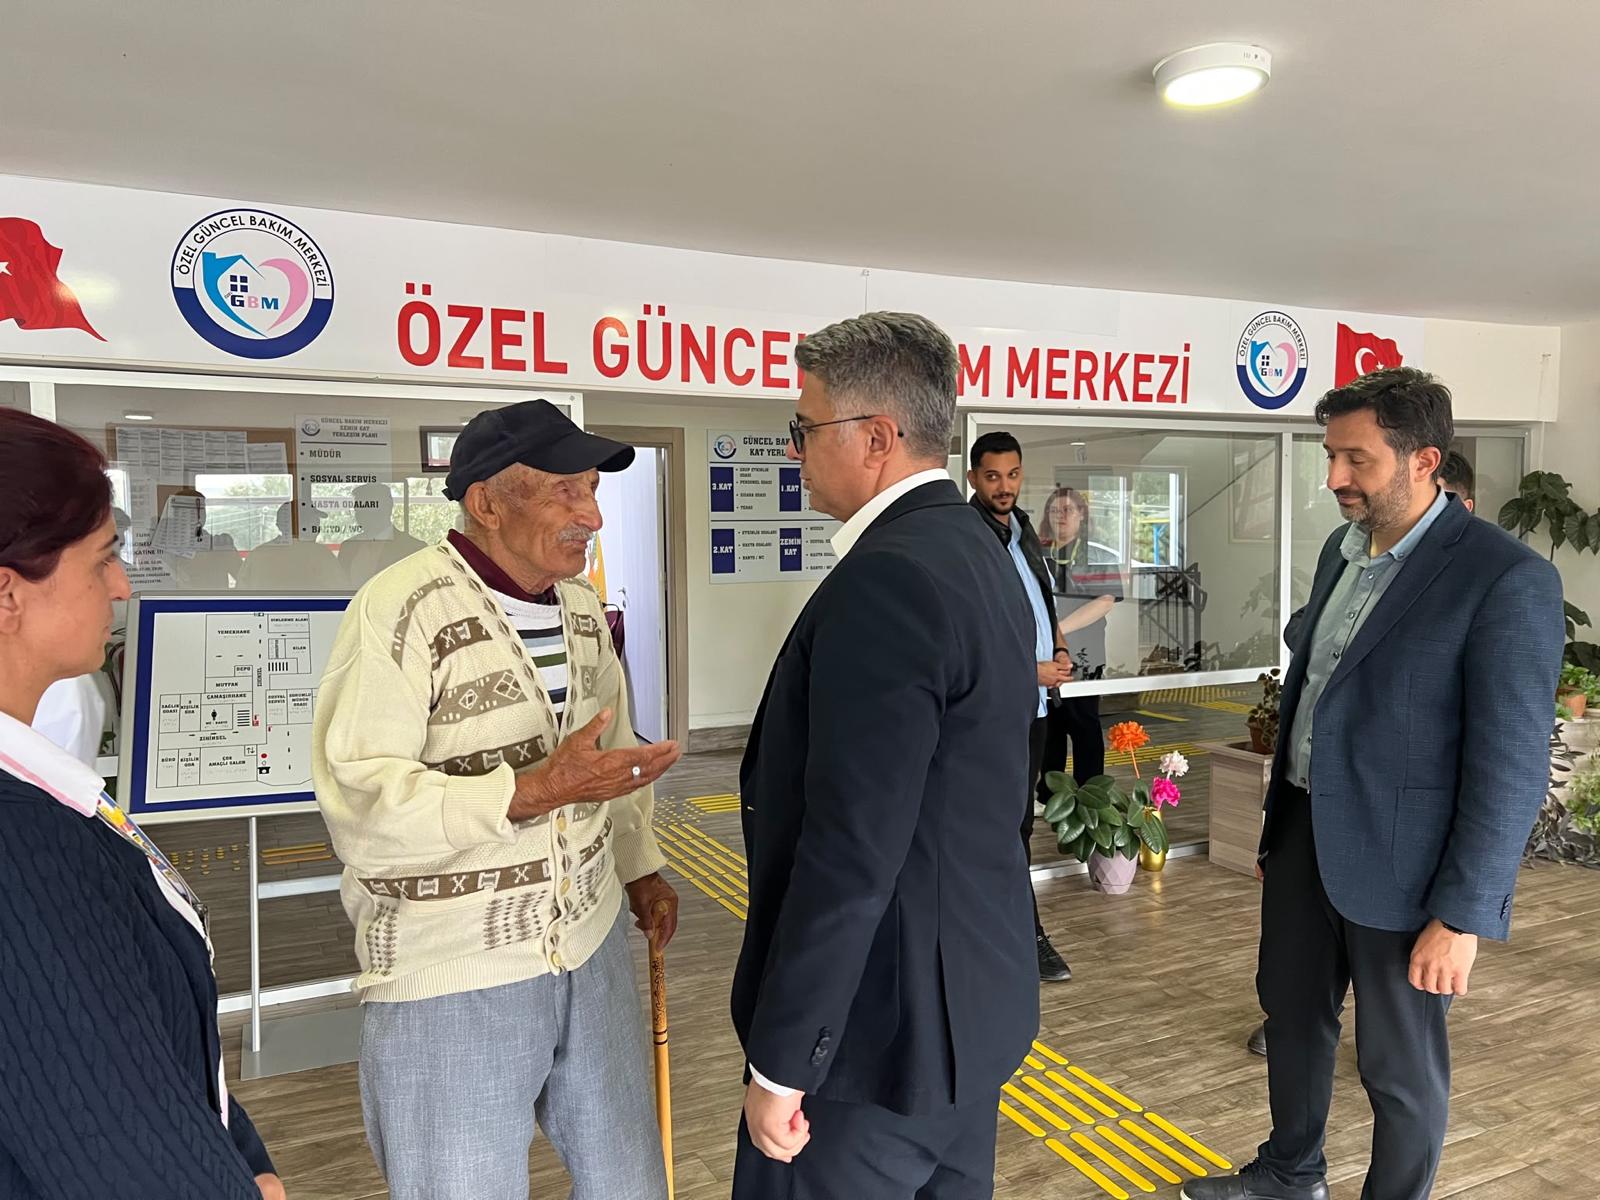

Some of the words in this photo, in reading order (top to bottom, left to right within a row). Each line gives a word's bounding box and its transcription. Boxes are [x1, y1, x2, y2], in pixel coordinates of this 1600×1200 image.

[176, 246, 198, 274] ÖZEL
[193, 215, 245, 244] GÜNCEL
[250, 216, 293, 239] BAKIM
[294, 237, 329, 287] MERKEZİ
[231, 294, 279, 310] GBM
[1273, 315, 1293, 329] BAKIM
[397, 282, 568, 374] ÖZEL
[1006, 343, 1190, 404] MERKEZİ
[1261, 368, 1282, 377] GBM
[743, 436, 773, 445] GÜNCEL
[309, 448, 342, 458] MÜDÜR
[750, 448, 764, 456] KAT
[767, 448, 786, 456] YERL
[310, 475, 343, 483] SOSYAL
[345, 474, 377, 483] SERVİS
[780, 537, 801, 546] ZEMİN
[784, 548, 797, 556] KAT
